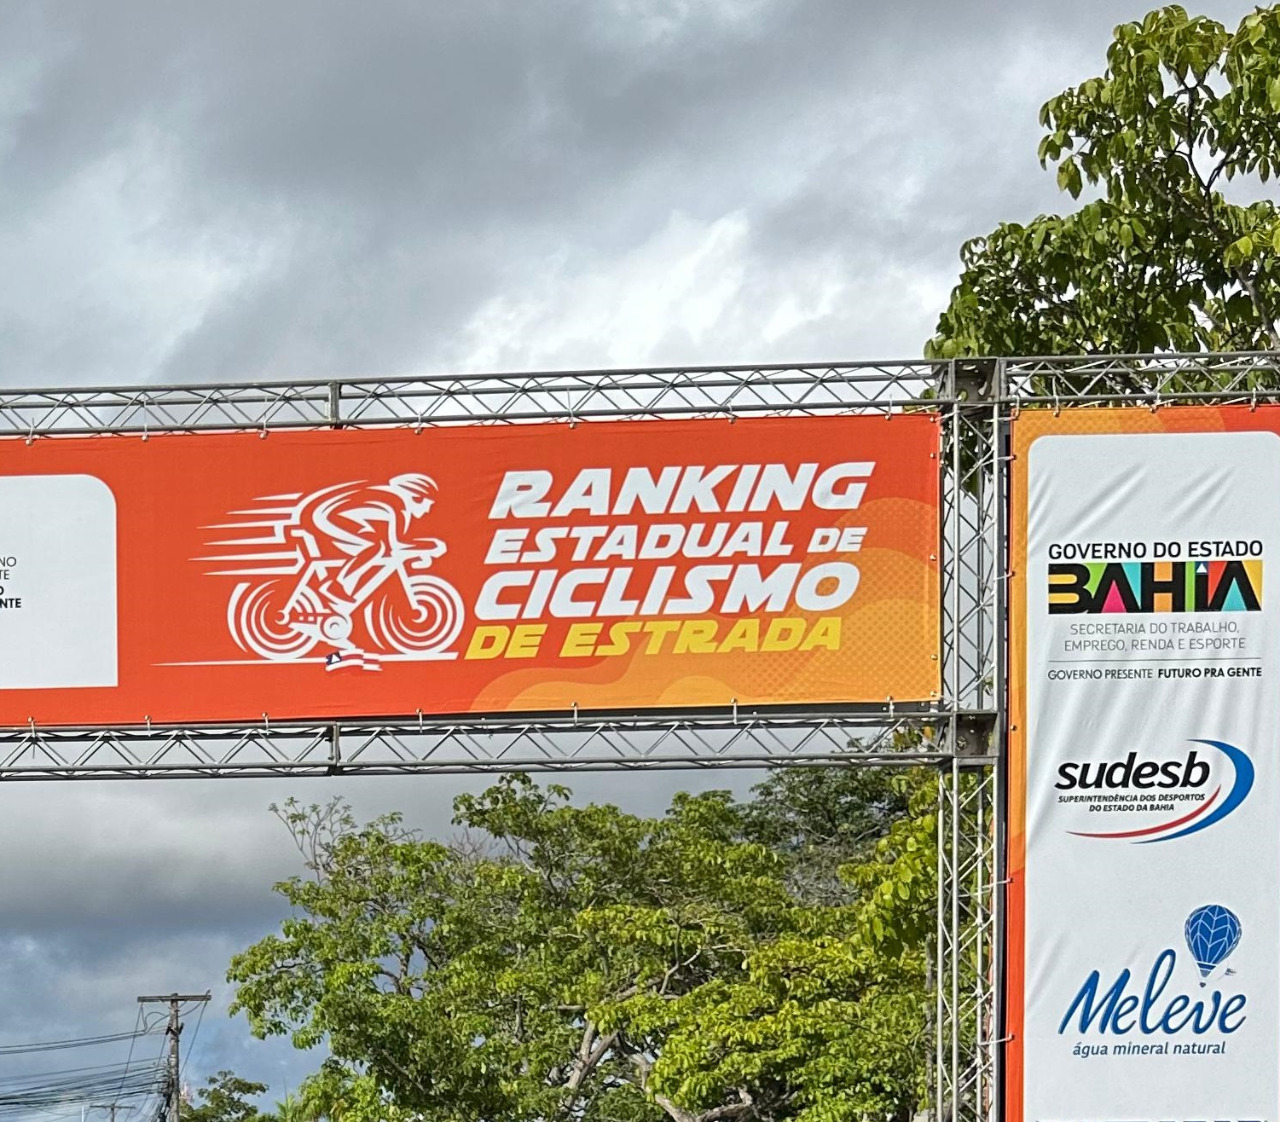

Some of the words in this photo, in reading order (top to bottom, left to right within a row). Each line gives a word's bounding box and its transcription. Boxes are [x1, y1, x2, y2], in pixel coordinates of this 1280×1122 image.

[488, 461, 876, 520] RANKING
[483, 520, 794, 564] ESTADUAL
[806, 526, 868, 553] DE
[1048, 542, 1147, 560] GOVERNO
[1153, 541, 1182, 559] DO
[1188, 540, 1263, 557] ESTADO
[474, 561, 861, 621] CICLISMO
[1048, 559, 1263, 615] BAHIA
[464, 623, 548, 660] DE
[559, 616, 843, 658] ESTRADA
[1070, 622, 1146, 635] SECRETARIA
[1149, 622, 1168, 634] DO
[1170, 621, 1240, 633] TRABALHO,
[1064, 639, 1127, 652] EMPREGO,
[1131, 639, 1174, 650] RENDA
[1178, 638, 1186, 649] E
[1189, 637, 1246, 649] ESPORTE
[1047, 669, 1103, 681] GOVERNO
[1104, 668, 1153, 680] PRESENTE
[1157, 667, 1201, 678] FUTURO
[1204, 667, 1225, 678] PRA
[1226, 666, 1262, 677] GENTE
[1054, 751, 1210, 790] sudesb
[1058, 793, 1138, 803] SUPERINTENDÊNCIA
[1139, 794, 1156, 802] DOS
[1158, 793, 1205, 802] DESPORTOS
[1089, 804, 1101, 812] DO
[1103, 803, 1135, 812] ESTADO
[1136, 803, 1148, 811] DA
[1149, 803, 1174, 811] BAHIA
[1058, 948, 1246, 1034] Meleve
[1072, 1042, 1108, 1058] água
[1113, 1041, 1168, 1055] mineral
[1173, 1041, 1226, 1054] natural
